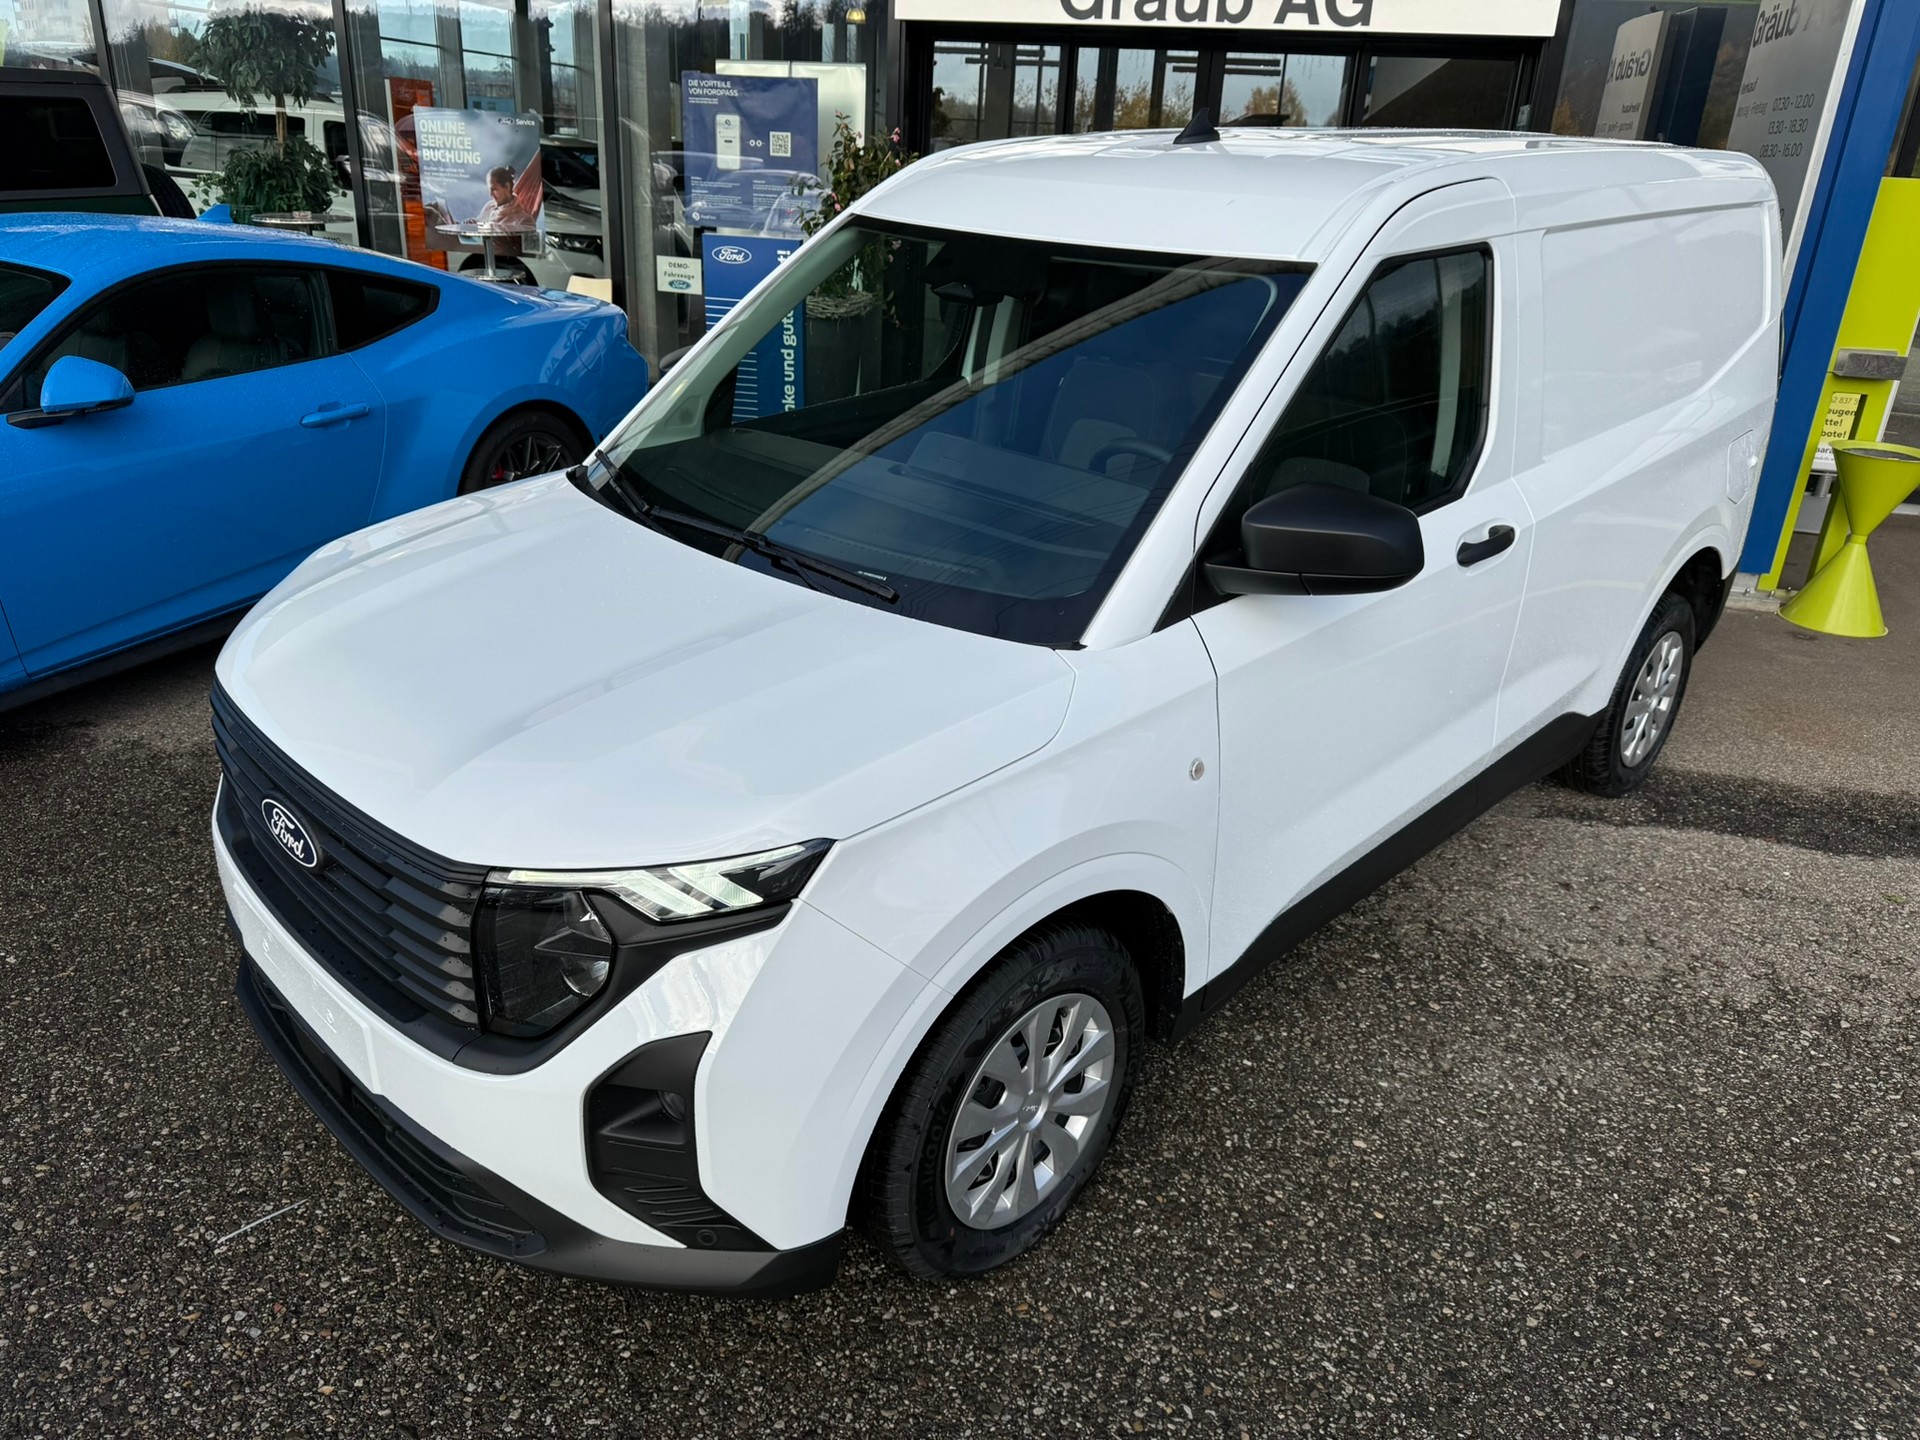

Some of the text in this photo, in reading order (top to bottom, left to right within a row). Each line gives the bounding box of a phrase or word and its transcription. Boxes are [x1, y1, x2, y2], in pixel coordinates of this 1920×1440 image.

[1752, 0, 1800, 48] Gräub
[688, 79, 732, 88] DIE VORTEILE
[688, 87, 739, 97] VON FORDPASS
[420, 119, 466, 135] ONLINE
[421, 134, 472, 150] SERVICE
[423, 148, 481, 164] BUCHUNG
[719, 247, 745, 261] Ford
[664, 271, 695, 280] Fahrzeuge
[672, 280, 688, 288] Ford
[780, 348, 795, 381] und
[1825, 418, 1843, 427] tte!
[1820, 428, 1847, 438] bote!
[271, 808, 305, 859] Ford
